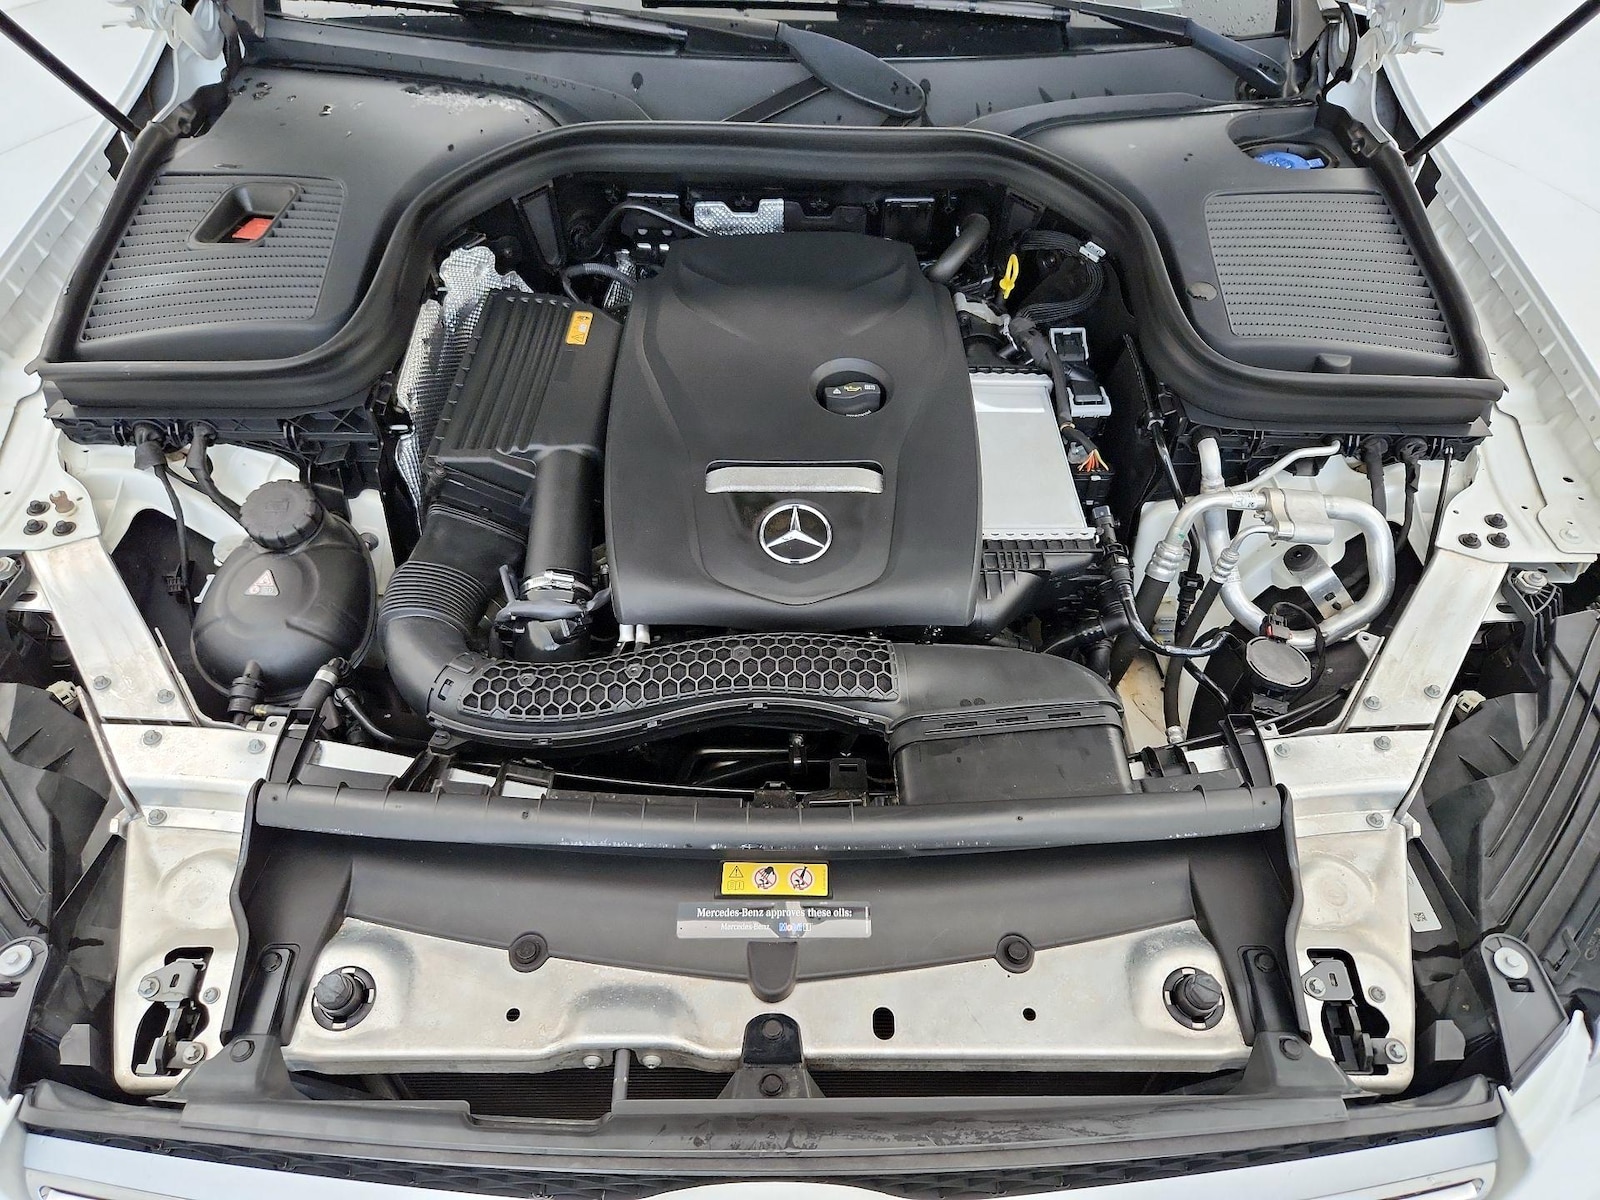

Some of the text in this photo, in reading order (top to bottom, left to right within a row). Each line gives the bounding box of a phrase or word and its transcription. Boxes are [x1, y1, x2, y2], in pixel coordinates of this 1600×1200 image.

[696, 907, 853, 919] Mercedes-Benz approves these oils:
[720, 923, 770, 931] Mercedes-Benz
